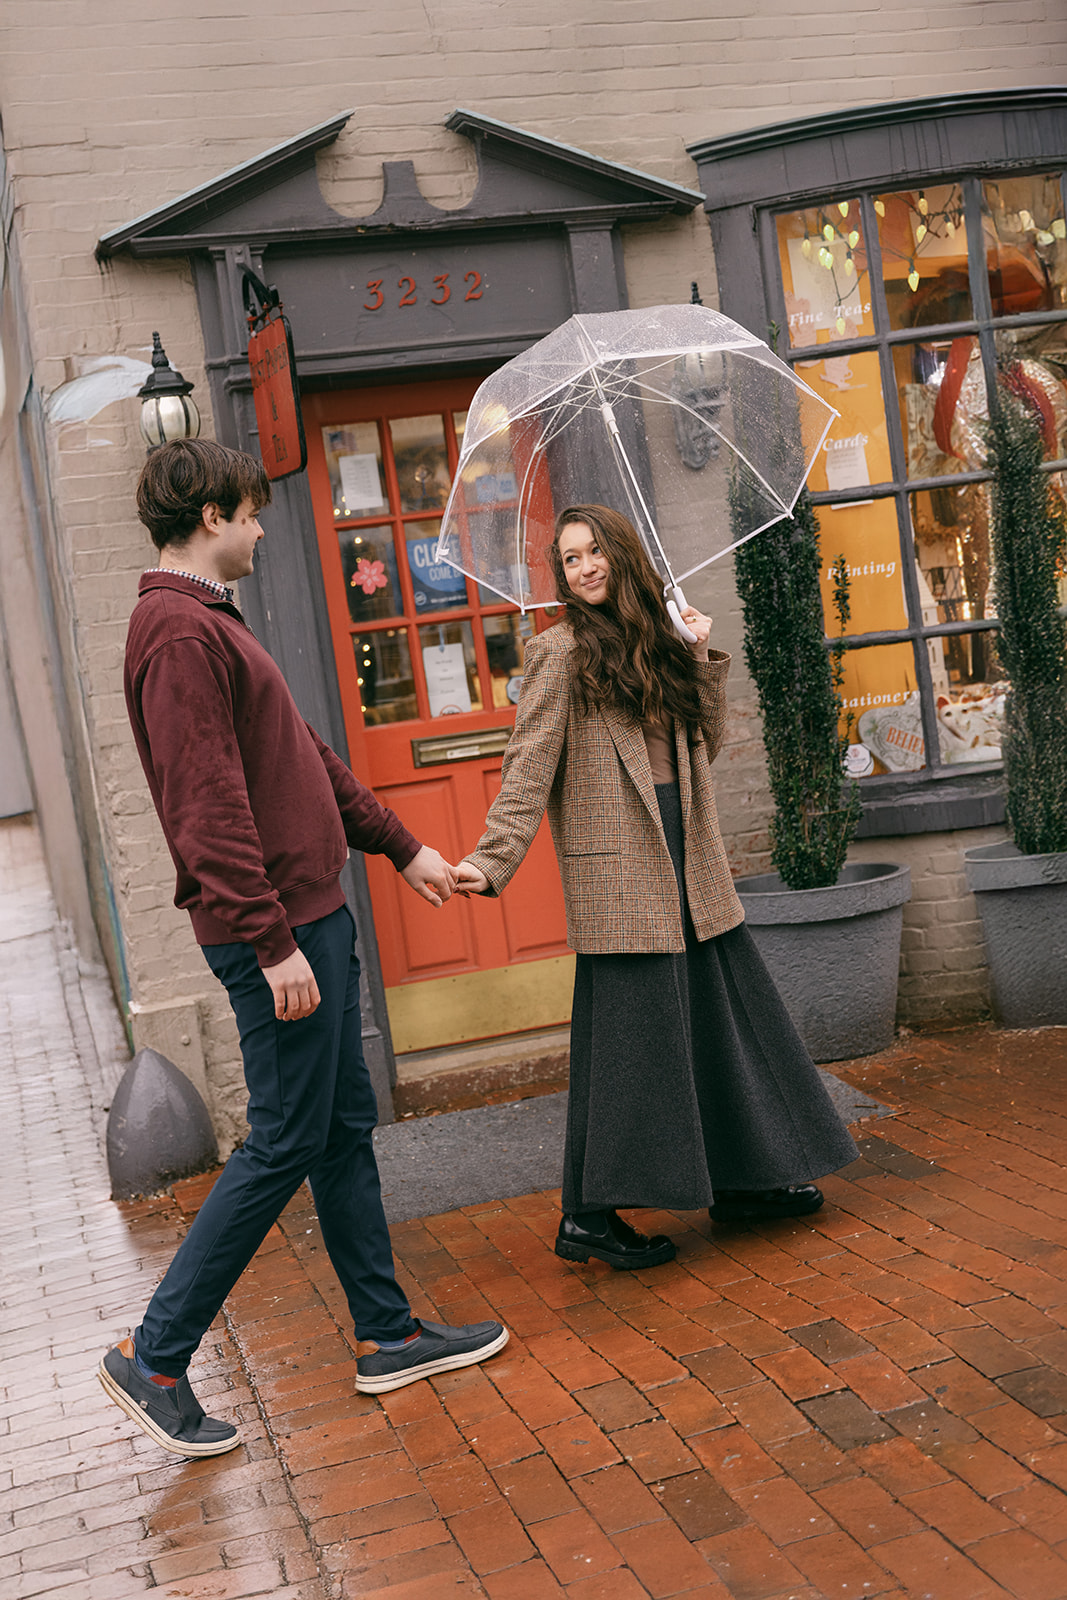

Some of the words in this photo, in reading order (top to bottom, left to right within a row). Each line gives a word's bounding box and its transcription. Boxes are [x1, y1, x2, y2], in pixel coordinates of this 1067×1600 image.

[363, 270, 483, 311] 3232
[790, 312, 823, 326] Fine
[833, 302, 871, 319] Teas
[265, 341, 288, 378] PAPER
[272, 434, 288, 462] TEA
[822, 433, 868, 451] Cards
[428, 566, 453, 581] COME
[841, 688, 920, 709] tationery
